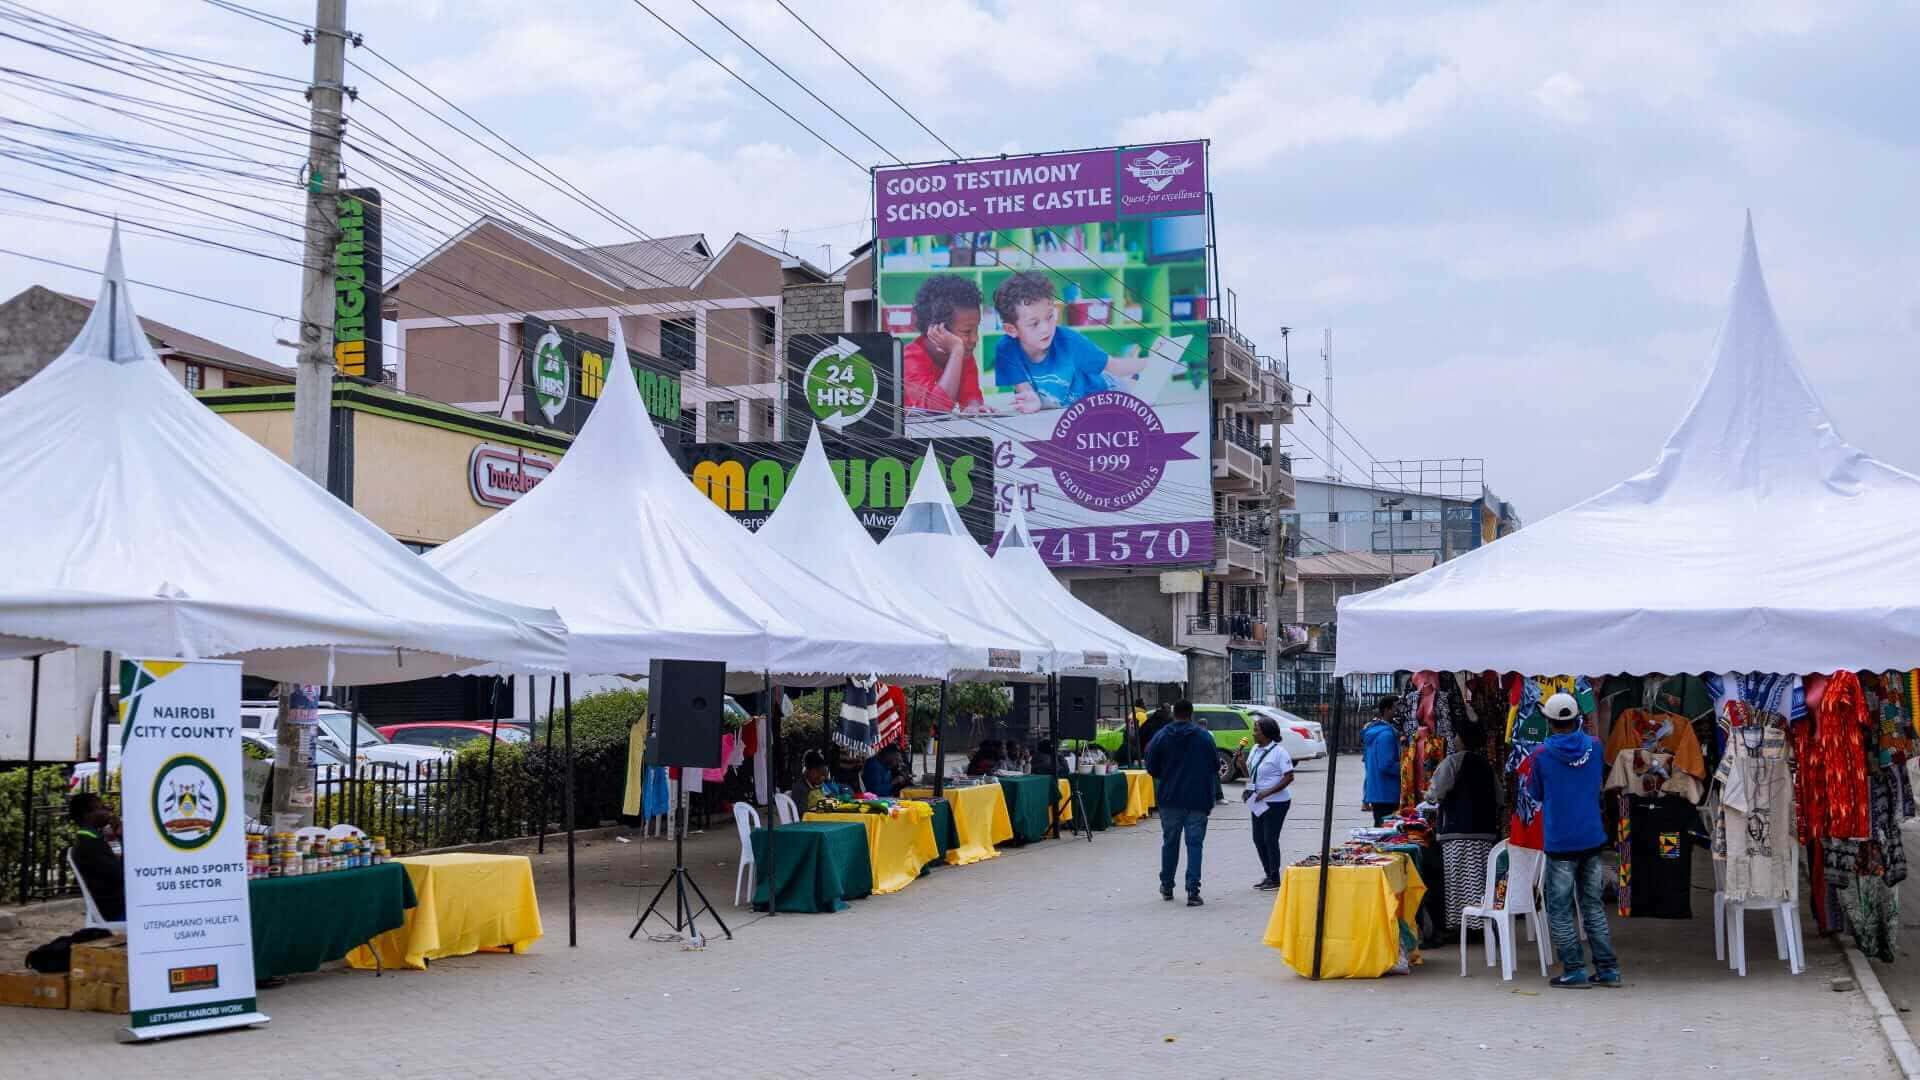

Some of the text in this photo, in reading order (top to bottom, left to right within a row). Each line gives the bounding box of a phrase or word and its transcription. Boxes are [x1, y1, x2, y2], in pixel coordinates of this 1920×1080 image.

[886, 163, 1081, 196] GOOD TESTIMONY
[886, 187, 1112, 223] SCHOOL- THE CASTLE
[1121, 189, 1201, 206] Quest for excellence
[826, 364, 856, 384] 24
[816, 387, 865, 407] HRS
[1055, 393, 1161, 438] GOOD TESTIMONY
[1076, 430, 1141, 450] SINCE
[1088, 454, 1131, 472] 1999
[693, 455, 975, 511] MAUNS
[1059, 465, 1159, 507] GROUP OF SCHOOLS
[863, 512, 900, 527] Mwa
[153, 706, 215, 720] NAIROBI
[134, 726, 234, 739] CITY COUNTY
[134, 863, 244, 878] YOUTH AND SPORTS
[156, 878, 222, 891] SUB SECTOR
[143, 914, 240, 930] UTENGAMANO HULETA
[174, 929, 206, 941] USAWA
[189, 1006, 219, 1018] NAIROBI
[220, 1004, 244, 1014] WORK
